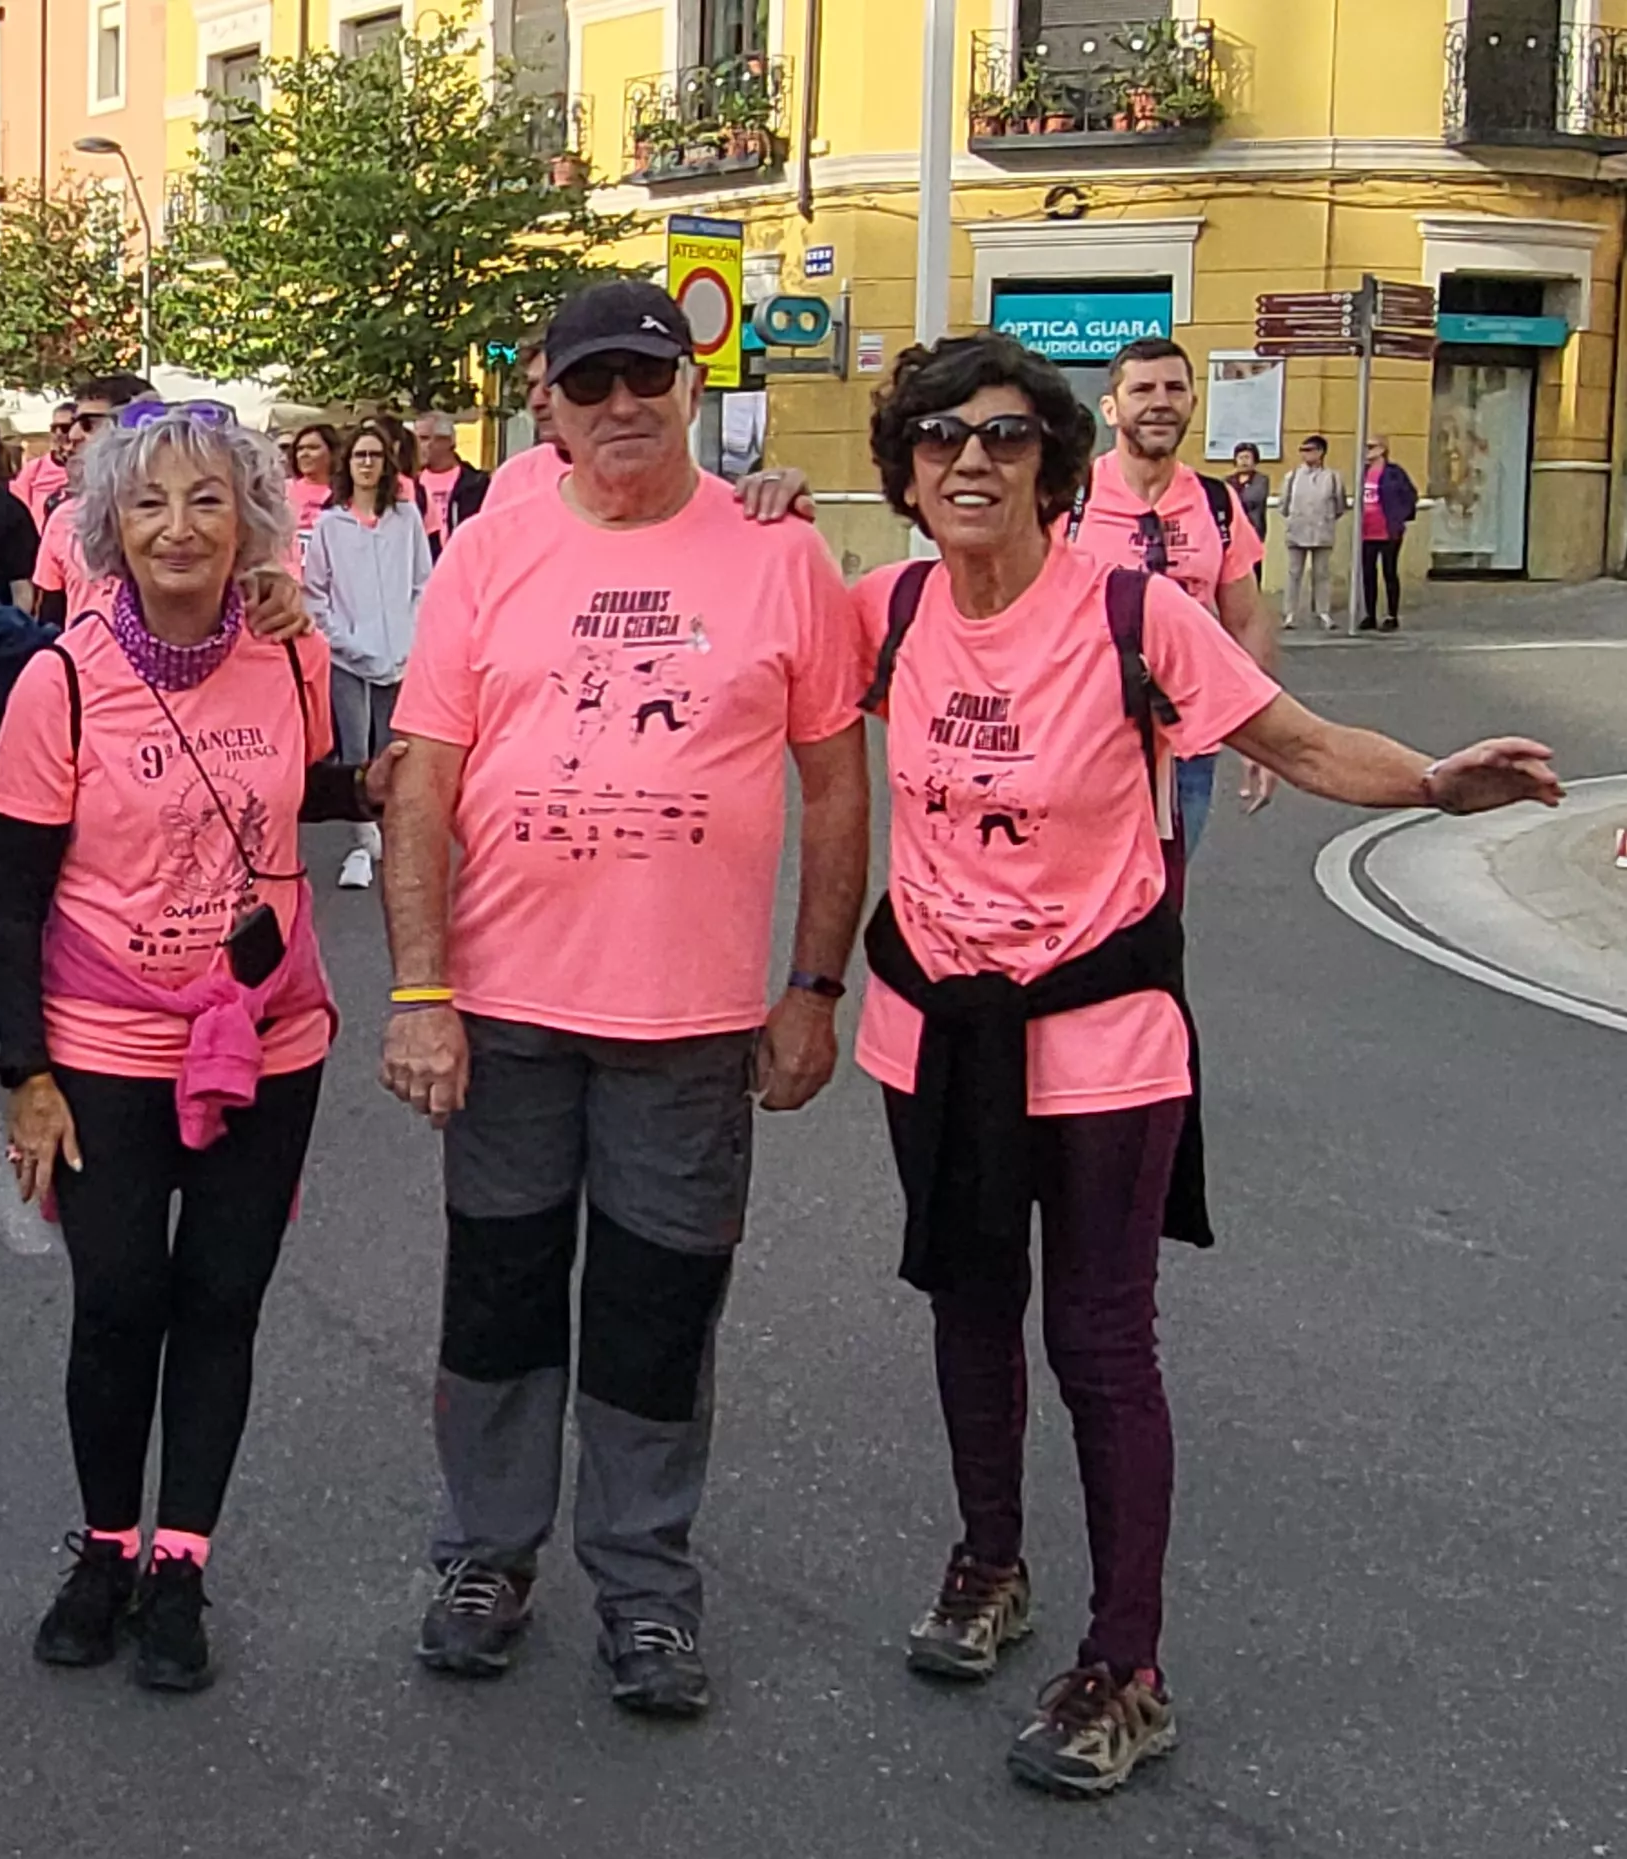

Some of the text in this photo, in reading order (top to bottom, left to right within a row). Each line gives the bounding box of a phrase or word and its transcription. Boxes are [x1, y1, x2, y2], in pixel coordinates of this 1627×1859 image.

[673, 243, 738, 262] ATENCIÓN
[999, 314, 1162, 338] ÓPTICA GUARA
